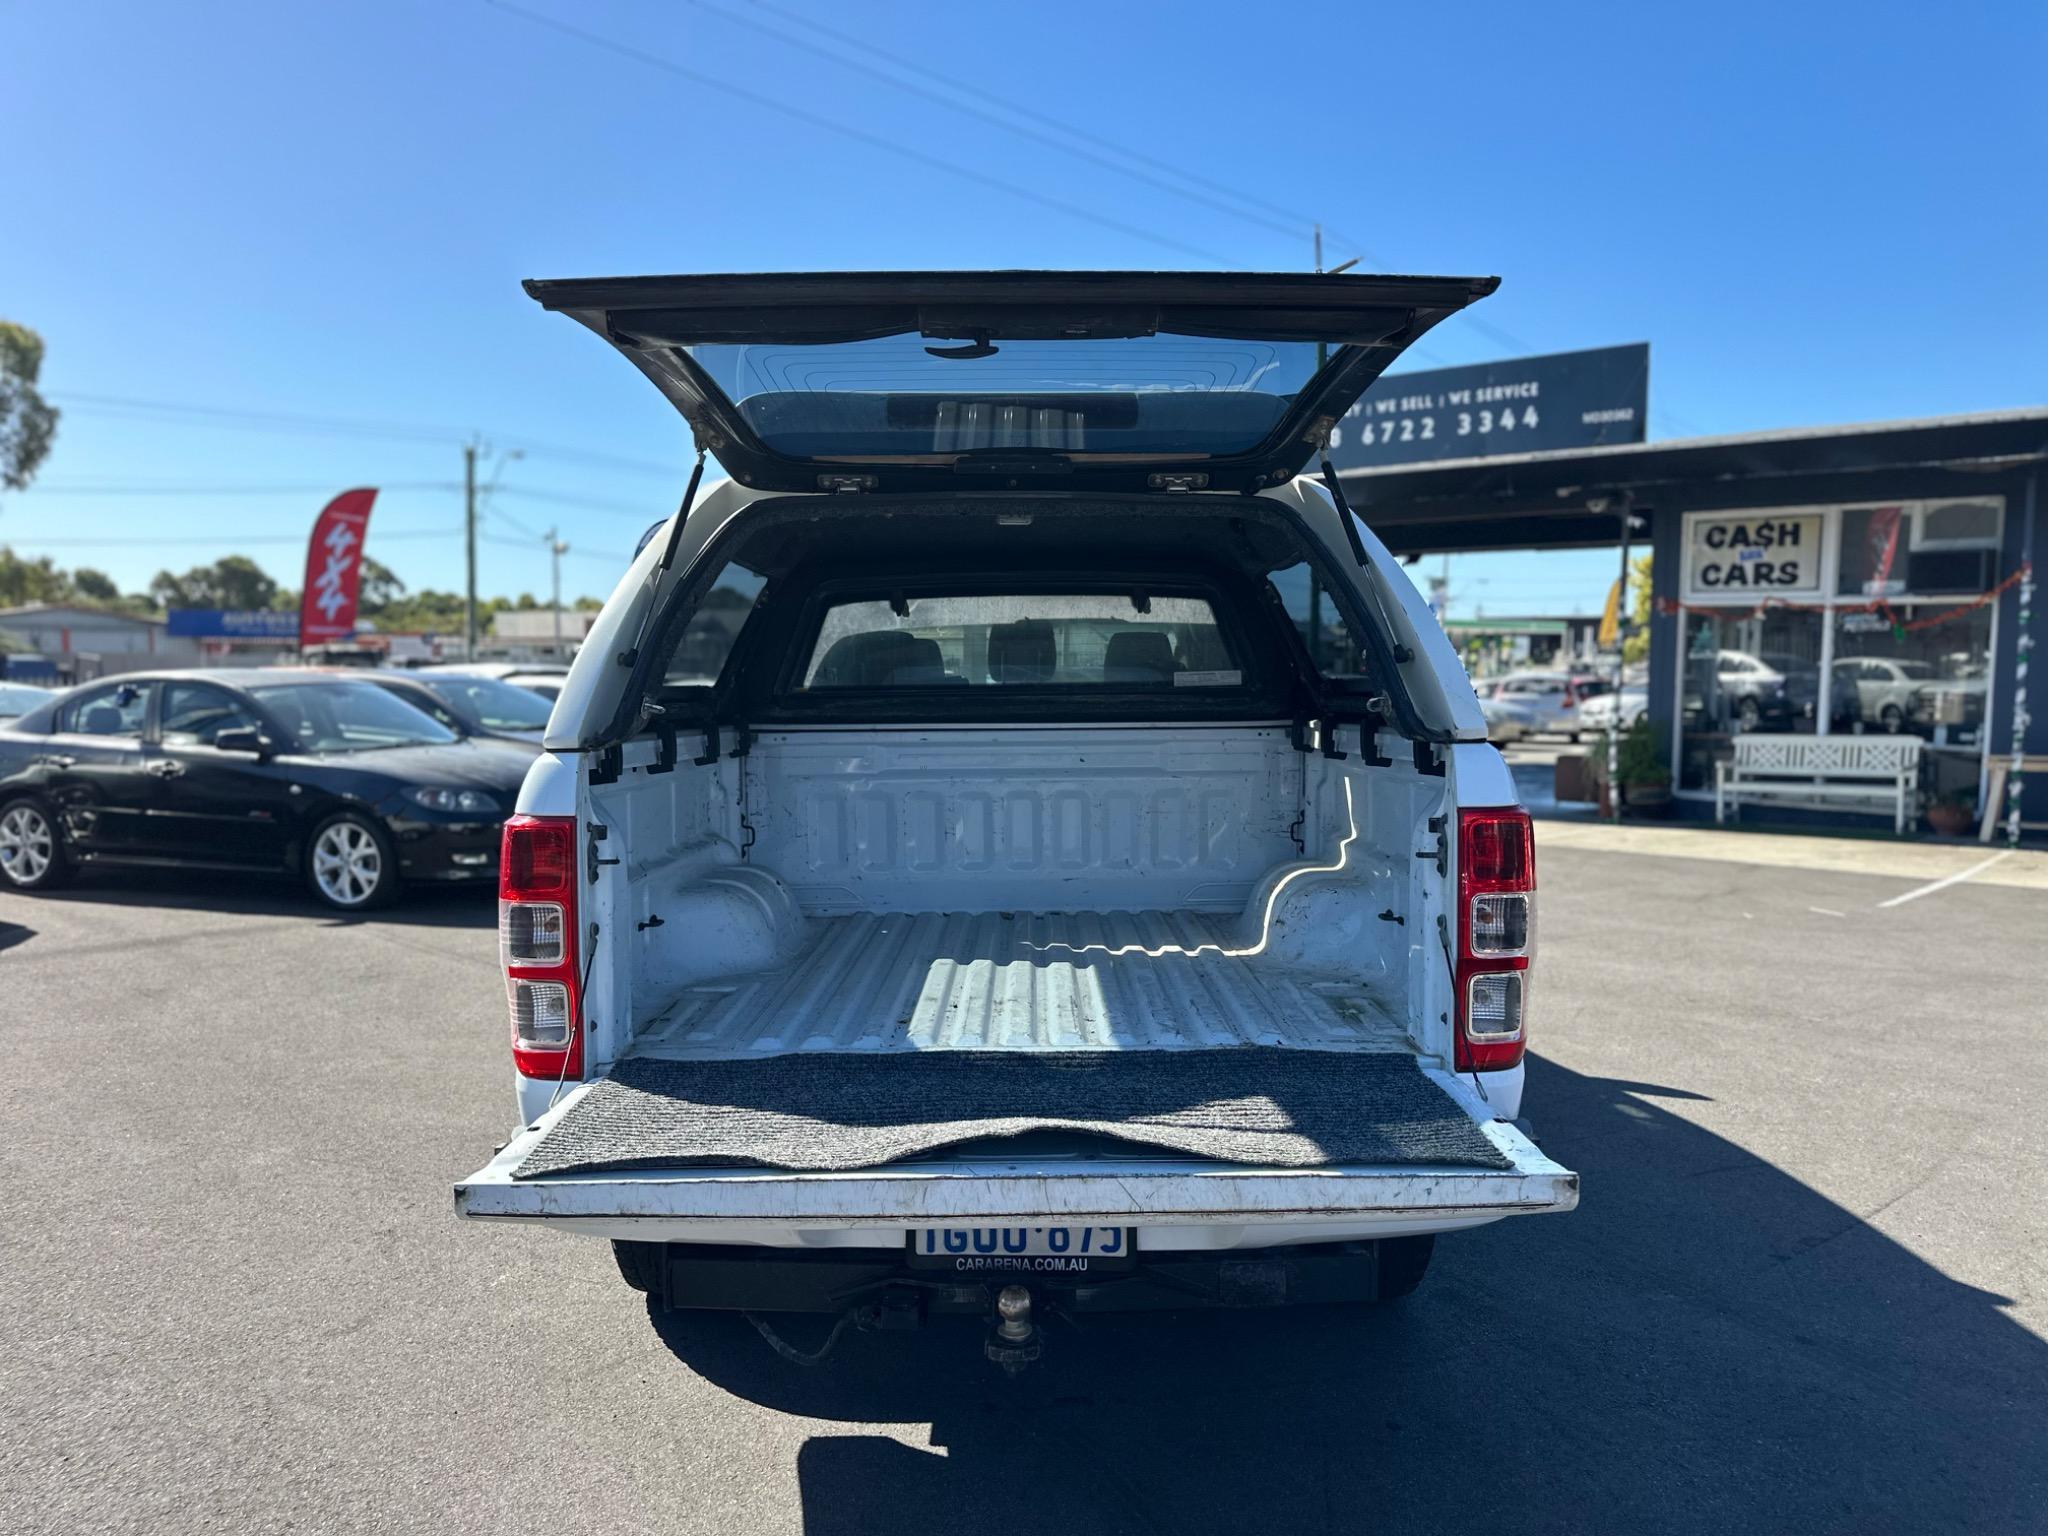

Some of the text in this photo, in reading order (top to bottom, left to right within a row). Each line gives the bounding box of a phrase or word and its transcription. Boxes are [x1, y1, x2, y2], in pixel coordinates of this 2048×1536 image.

[1375, 398, 1397, 414] WE
[1400, 394, 1433, 412] SELL
[1448, 389, 1471, 405] WE
[1475, 381, 1539, 403] SERVICE
[1361, 415, 1435, 446] 6722
[1457, 405, 1540, 436] 3344
[1701, 561, 1799, 587] CARS
[956, 1257, 1088, 1272] CARARENA.COM.AU
